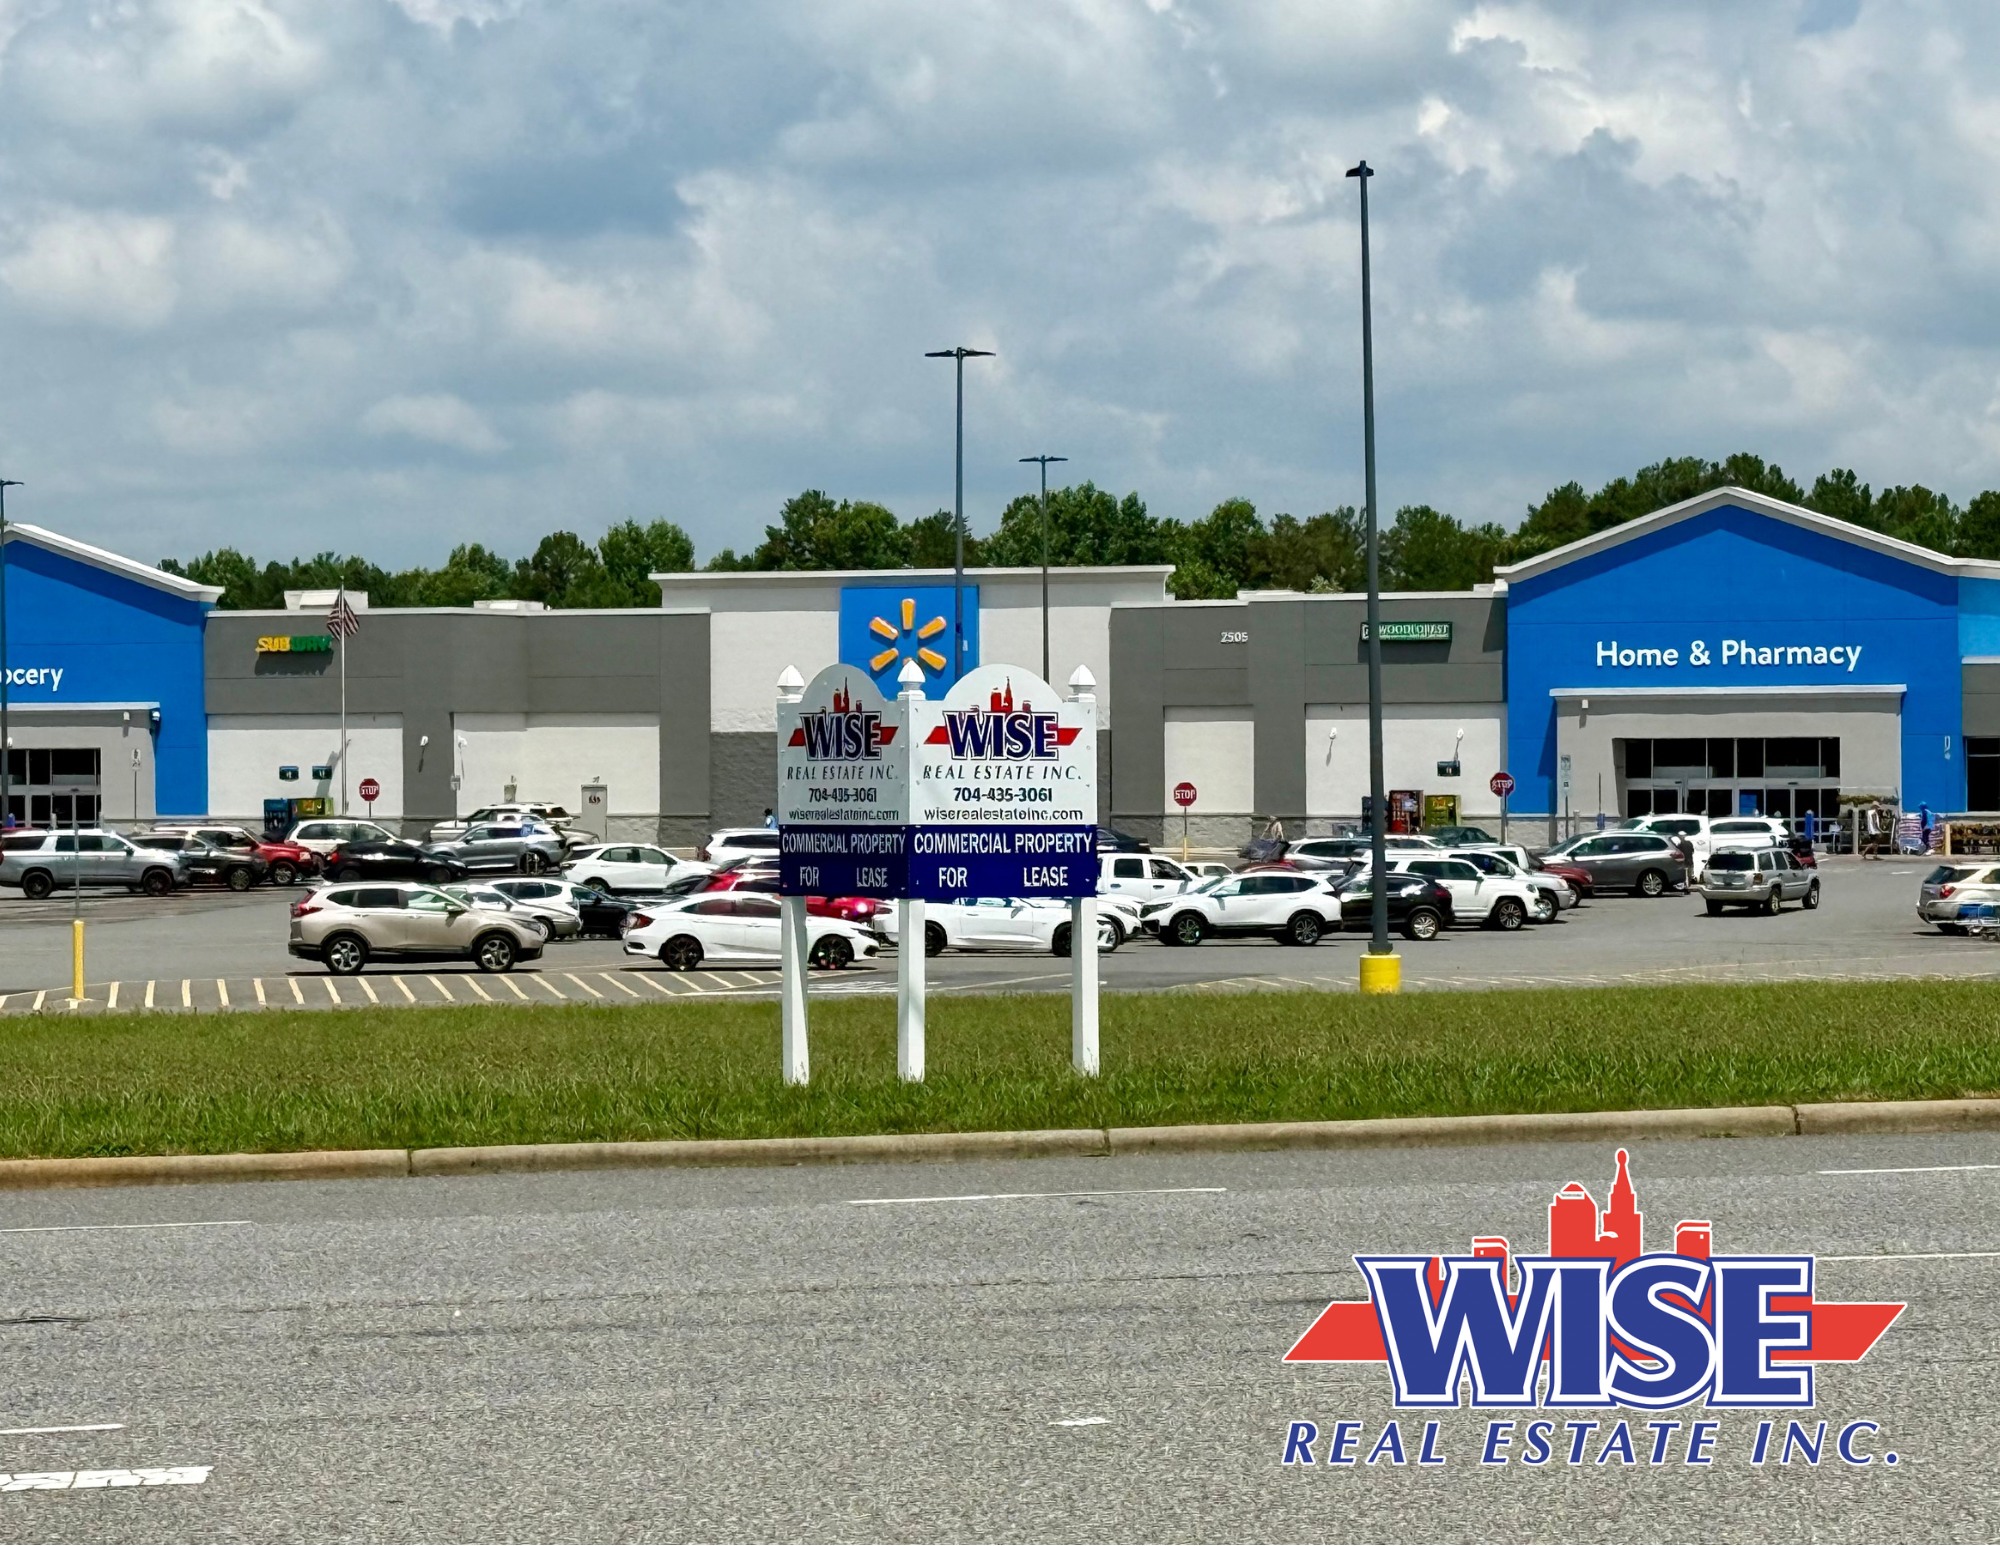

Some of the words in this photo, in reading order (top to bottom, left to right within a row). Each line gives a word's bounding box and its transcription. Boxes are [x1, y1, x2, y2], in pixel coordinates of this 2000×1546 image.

[255, 634, 333, 653] SUBWAY
[1220, 631, 1249, 643] 2505
[1596, 640, 1679, 667] Home
[1689, 639, 1711, 666] &
[1721, 639, 1863, 672] Pharmacy
[799, 710, 882, 761] WISE
[943, 711, 1059, 761] WISE
[787, 766, 817, 780] REAL
[822, 765, 864, 780] ESTATE
[869, 764, 899, 780] INC.
[923, 765, 965, 780] REAL
[973, 765, 1035, 780] ESTATE
[1042, 765, 1082, 780] INC.
[360, 785, 379, 795] STOP
[808, 787, 878, 803] 704-435-3061
[953, 787, 1053, 802] 704-435-3061
[1174, 789, 1196, 800] STOP
[788, 807, 899, 821] wiserealestateinc.com
[924, 807, 1083, 821] wiserealestateinc.com
[782, 833, 848, 853] COMMERCIAL
[850, 833, 906, 854] PROPERTY
[914, 833, 1011, 854] COMMERCIAL
[1014, 833, 1093, 854] PROPERTY
[799, 866, 820, 887] FOR
[856, 867, 888, 888] LEASE
[938, 866, 968, 888] FOR
[1023, 866, 1069, 887] LEASE
